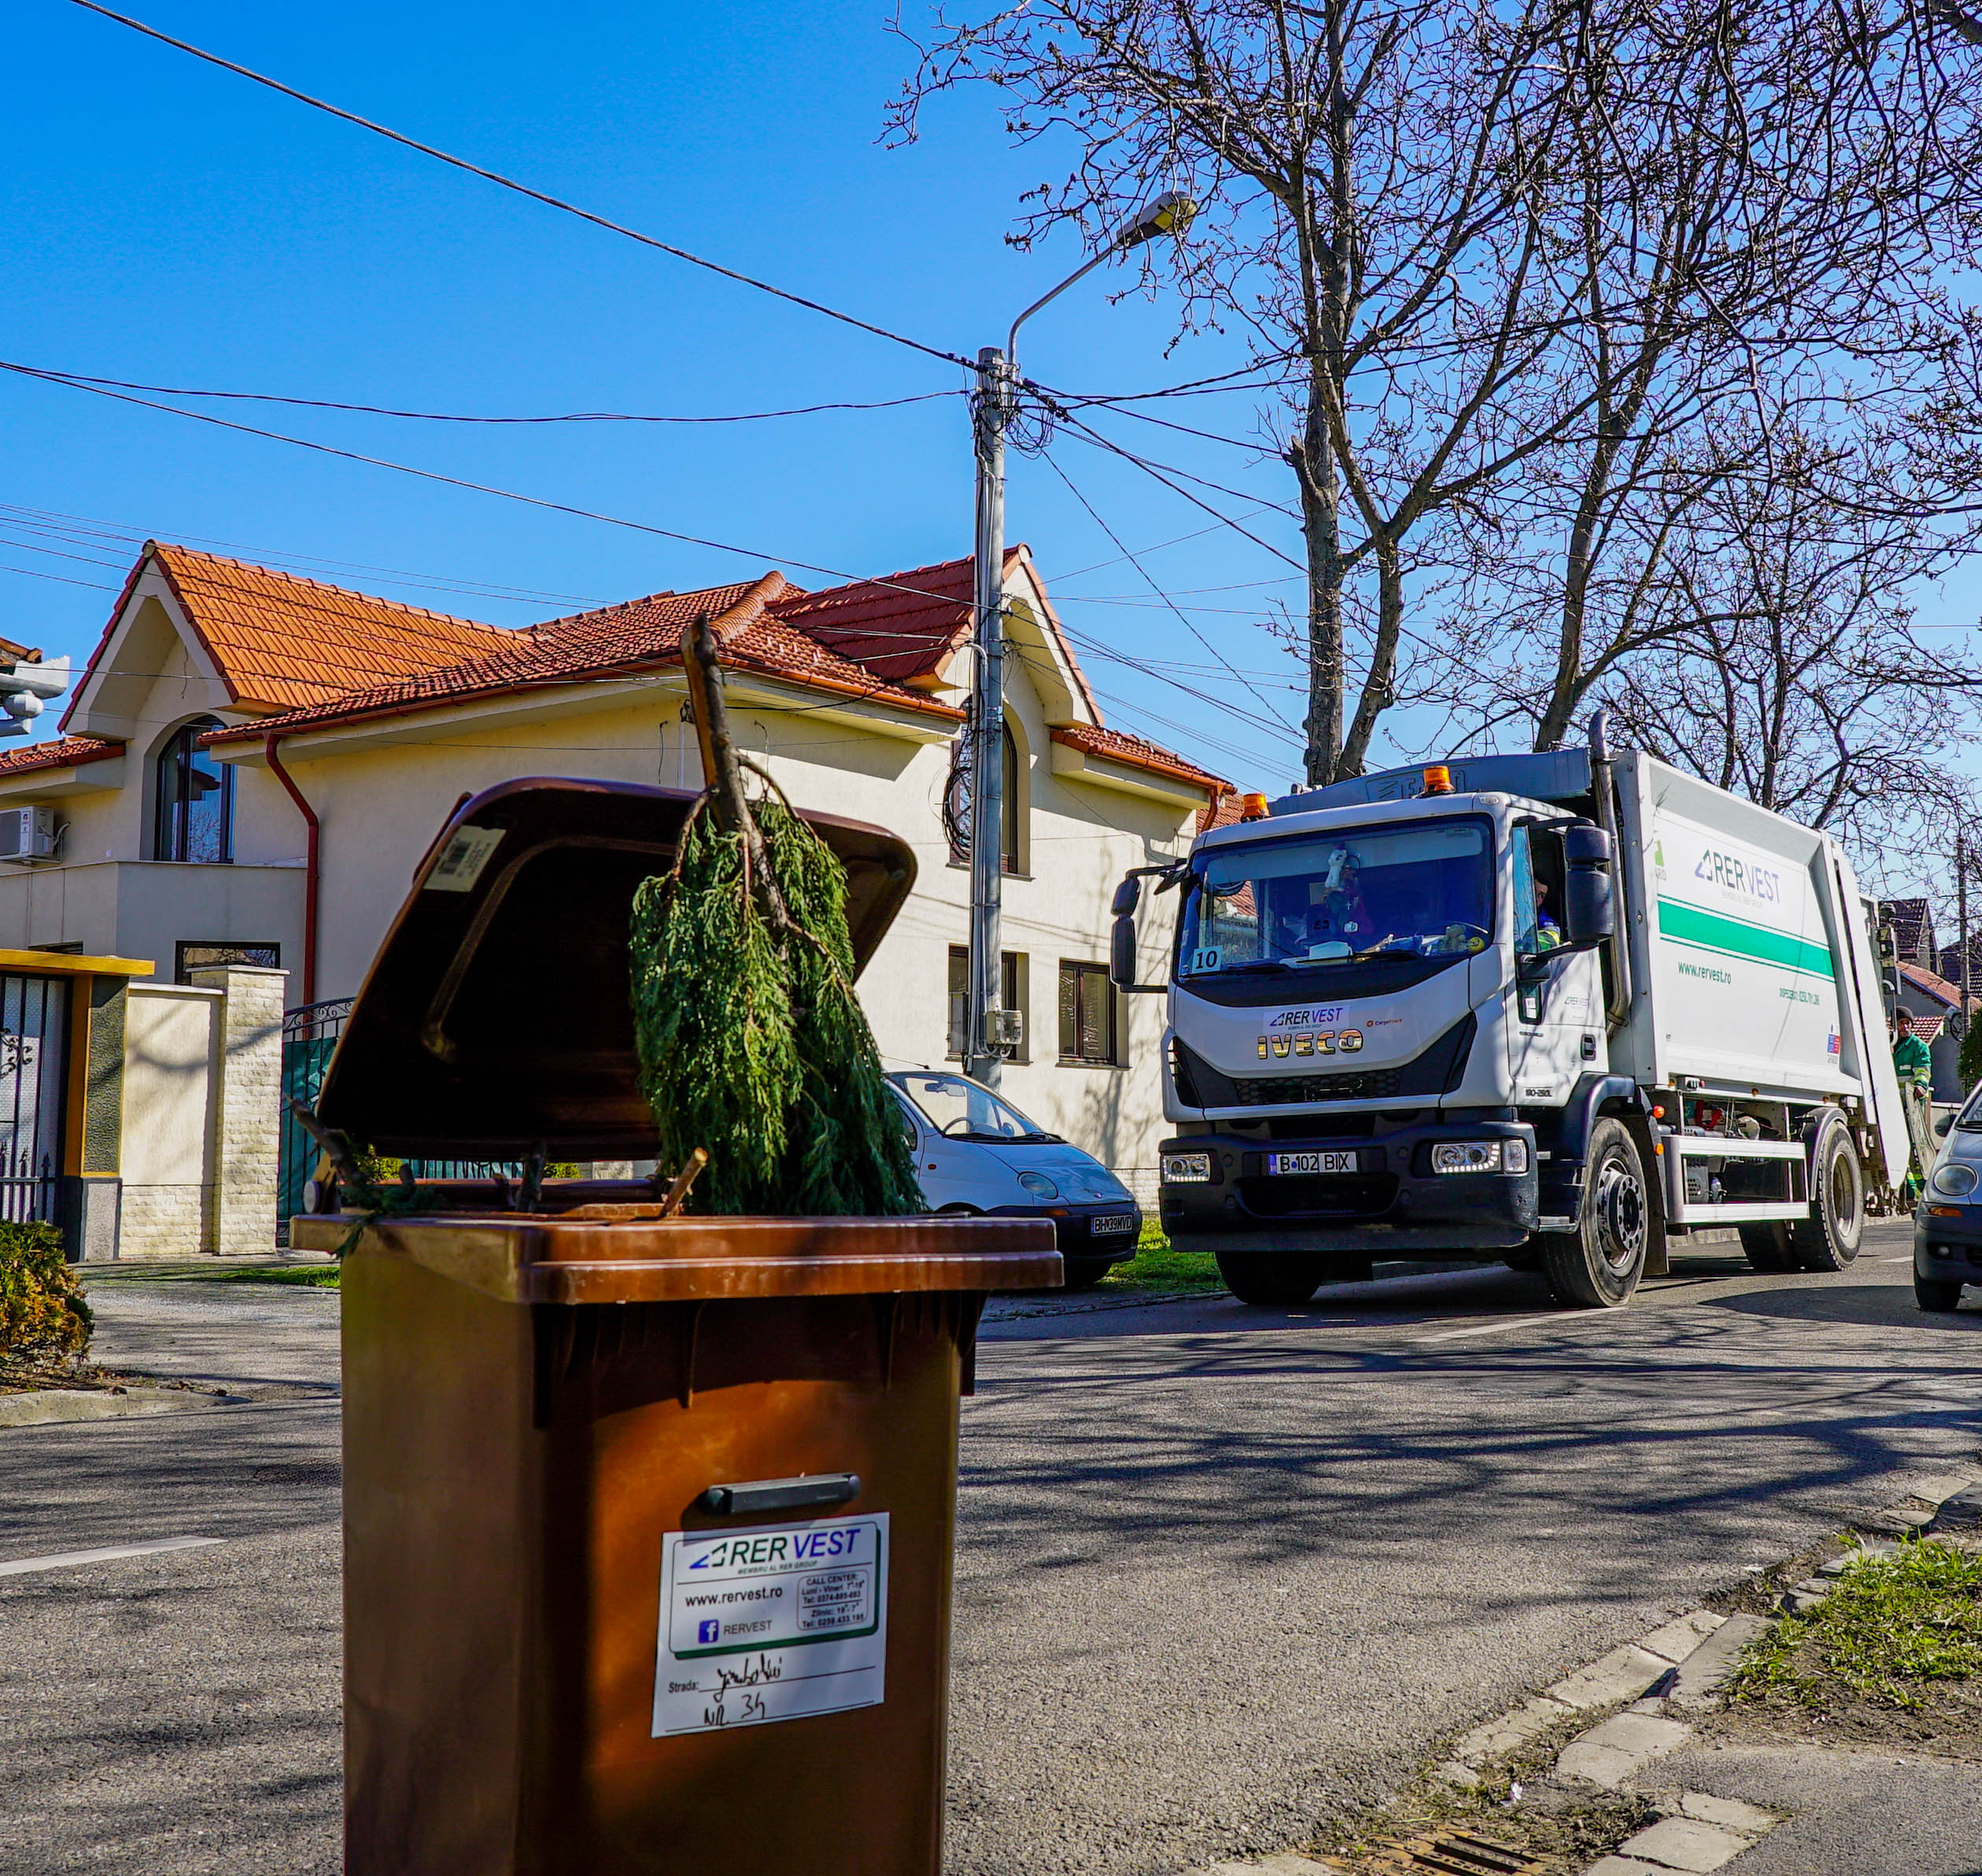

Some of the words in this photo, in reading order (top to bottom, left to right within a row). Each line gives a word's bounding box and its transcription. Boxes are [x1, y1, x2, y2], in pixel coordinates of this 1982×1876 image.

[1713, 851, 1746, 892] RER
[1744, 862, 1780, 904] VEST
[1195, 950, 1218, 969] 10
[1678, 961, 1731, 984] www.rervest.ro
[1284, 1010, 1310, 1025] RER
[1312, 1007, 1343, 1023] VEST
[1257, 1028, 1364, 1059] IVECO
[729, 1536, 788, 1566] RER
[793, 1528, 861, 1559] VEST
[806, 1577, 825, 1586] CALL
[685, 1586, 783, 1607] www.rervest.ro
[723, 1619, 773, 1634] RERVEST
[668, 1680, 699, 1693] Strada:
